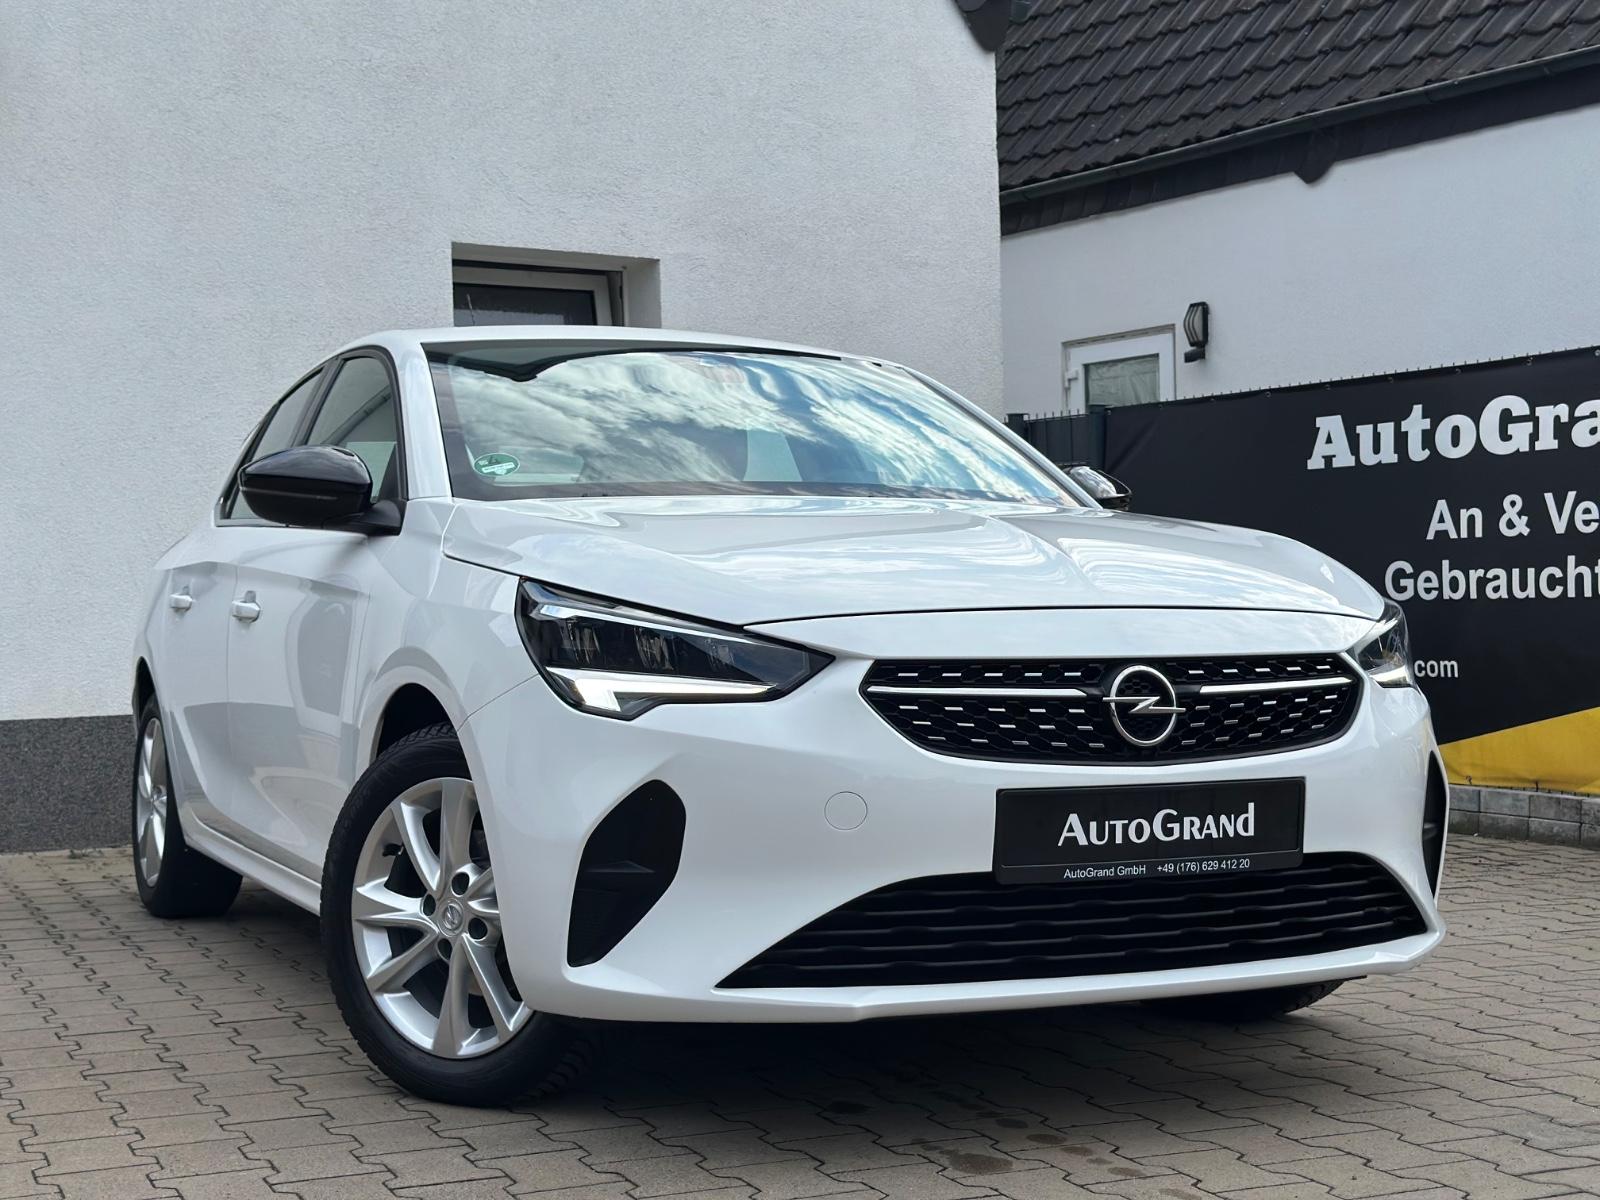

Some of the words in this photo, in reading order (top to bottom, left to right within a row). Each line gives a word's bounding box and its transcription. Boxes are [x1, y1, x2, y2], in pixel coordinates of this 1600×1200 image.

[1307, 394, 1600, 470] AutoGra
[1426, 499, 1483, 540] An
[1499, 494, 1531, 537] &
[1543, 490, 1600, 535] Ve
[1063, 866, 1115, 879] AutoGrand
[1117, 864, 1146, 876] GmbH
[1156, 863, 1175, 873] +49
[1176, 861, 1200, 875] (176)
[1201, 860, 1219, 871] 629
[1220, 859, 1237, 869] 412
[1239, 858, 1250, 869] 20
